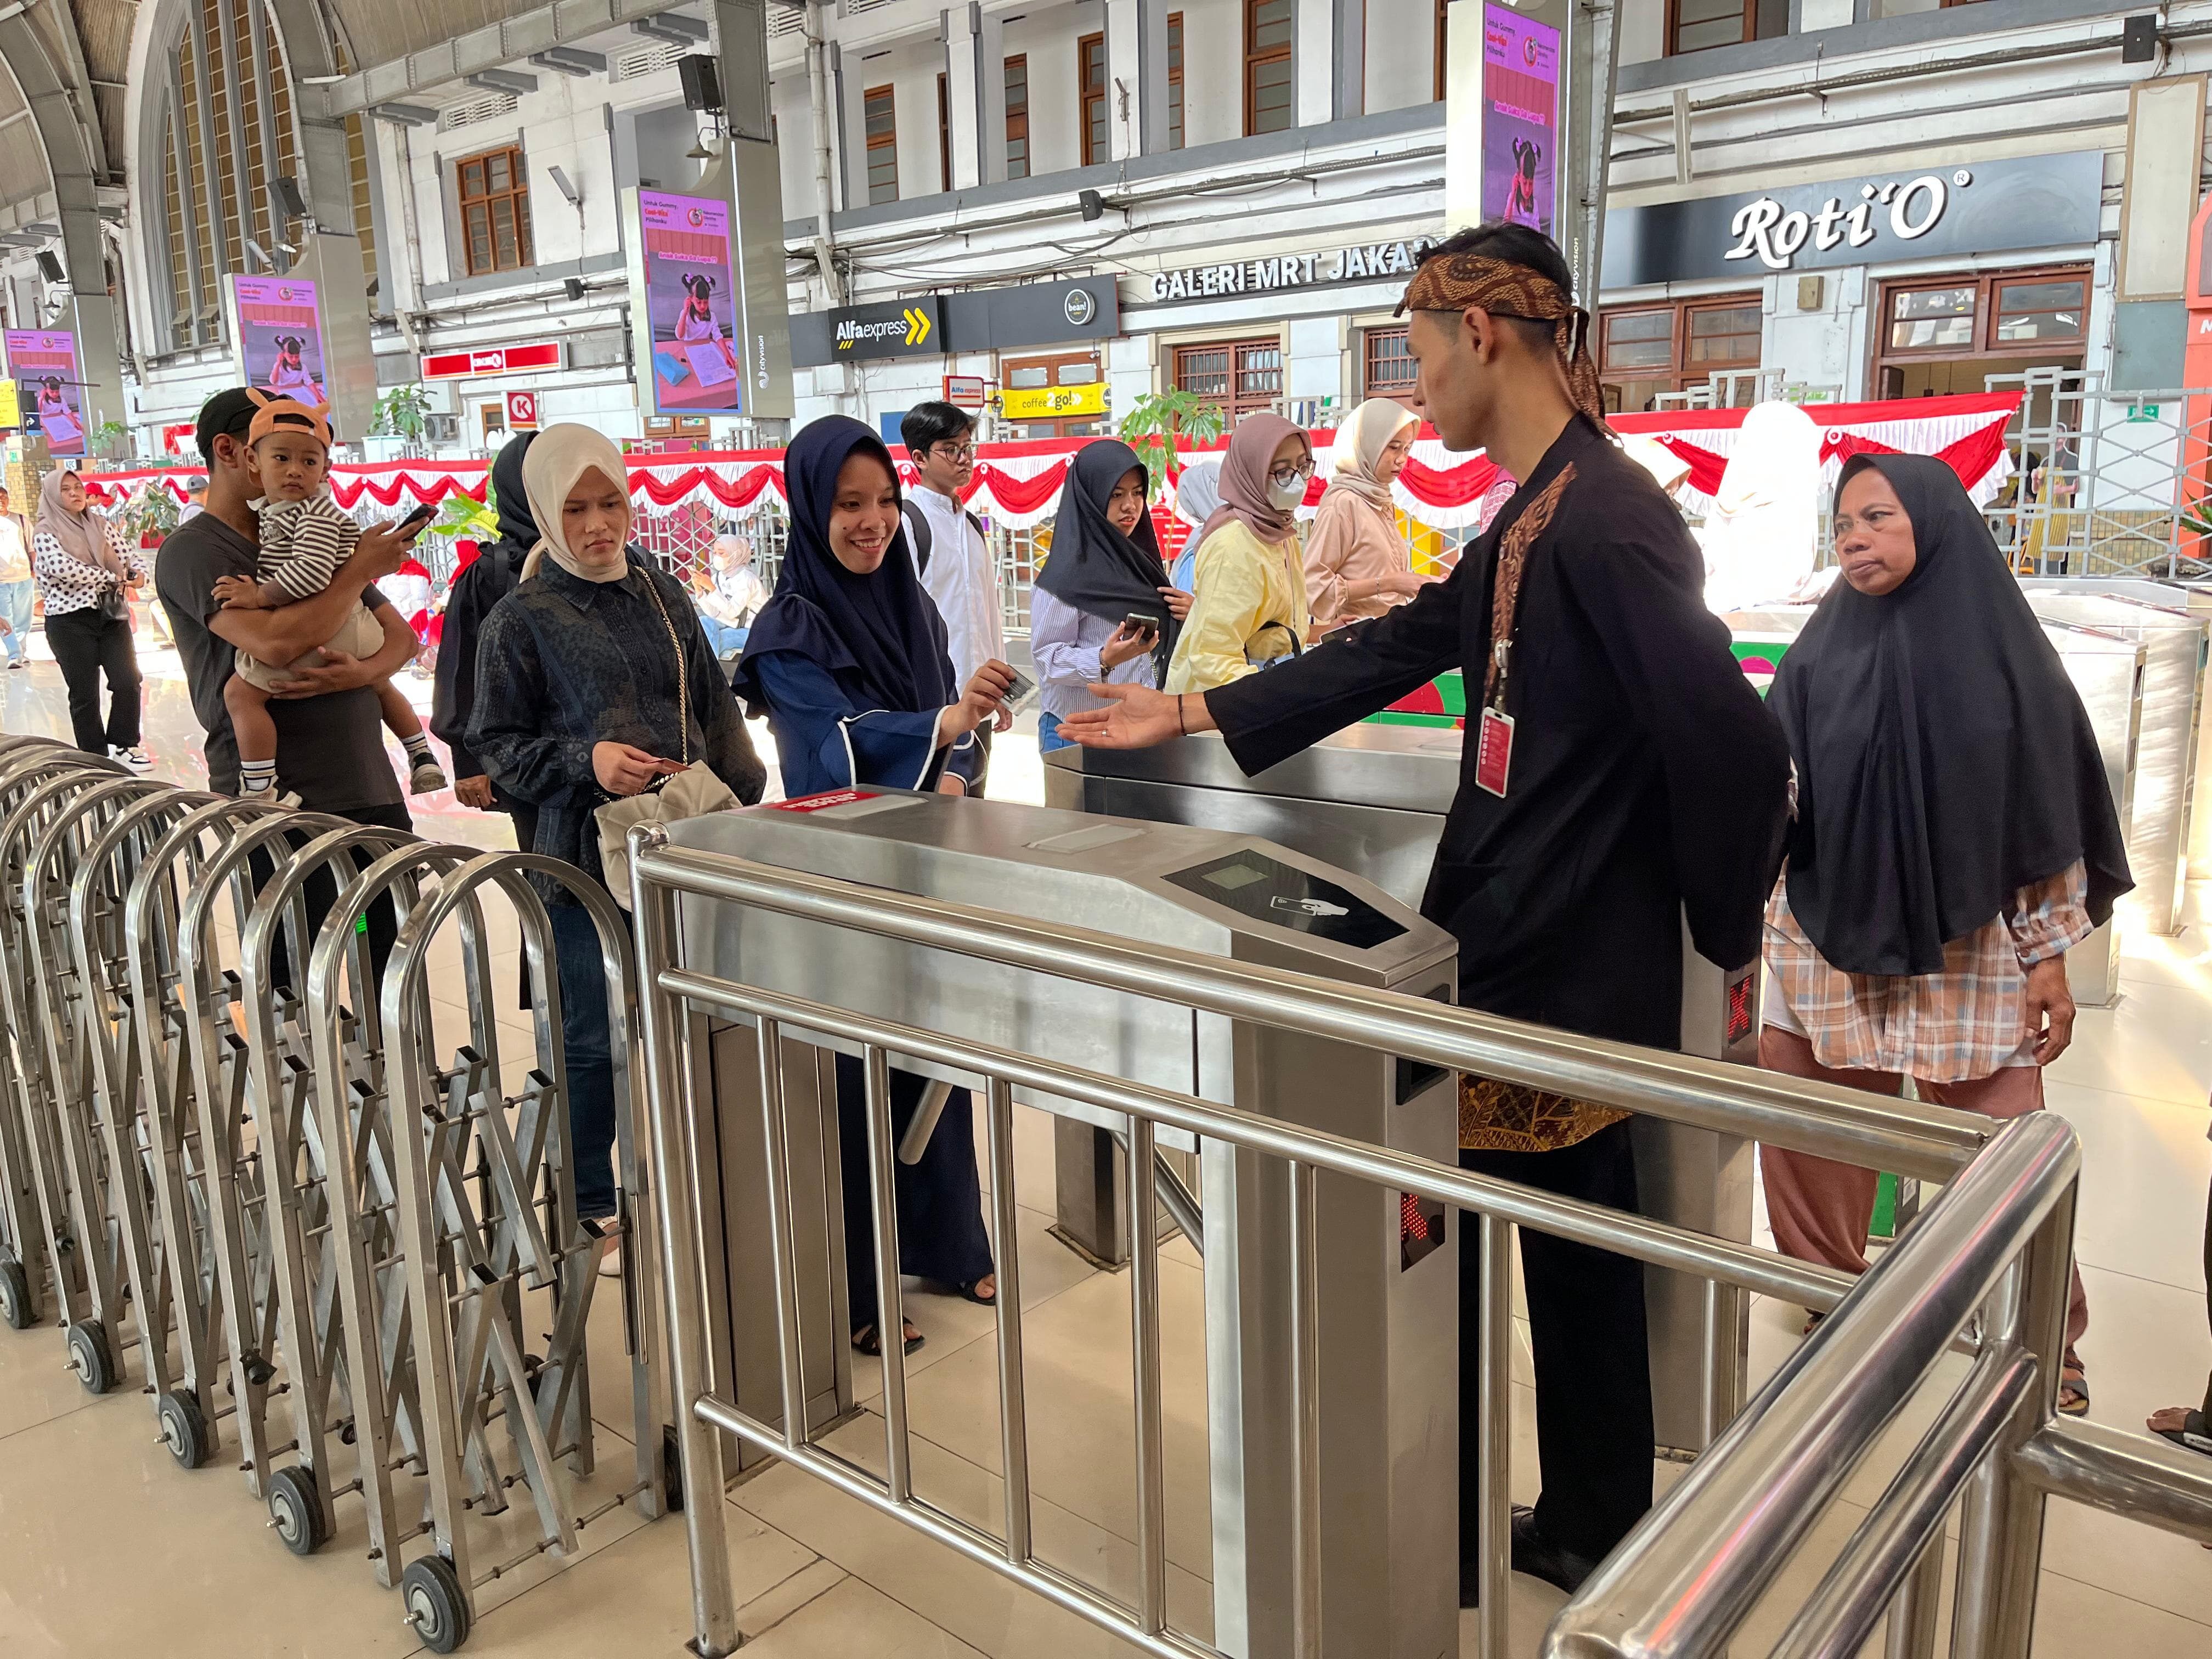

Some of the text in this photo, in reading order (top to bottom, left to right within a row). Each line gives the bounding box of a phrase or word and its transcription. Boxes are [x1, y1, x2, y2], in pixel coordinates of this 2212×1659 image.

[1150, 263, 1247, 300] GALERI
[1255, 253, 1322, 290] MRT
[1068, 301, 1086, 312] bean!
[758, 335, 766, 370] cityvision
[517, 400, 530, 416] K
